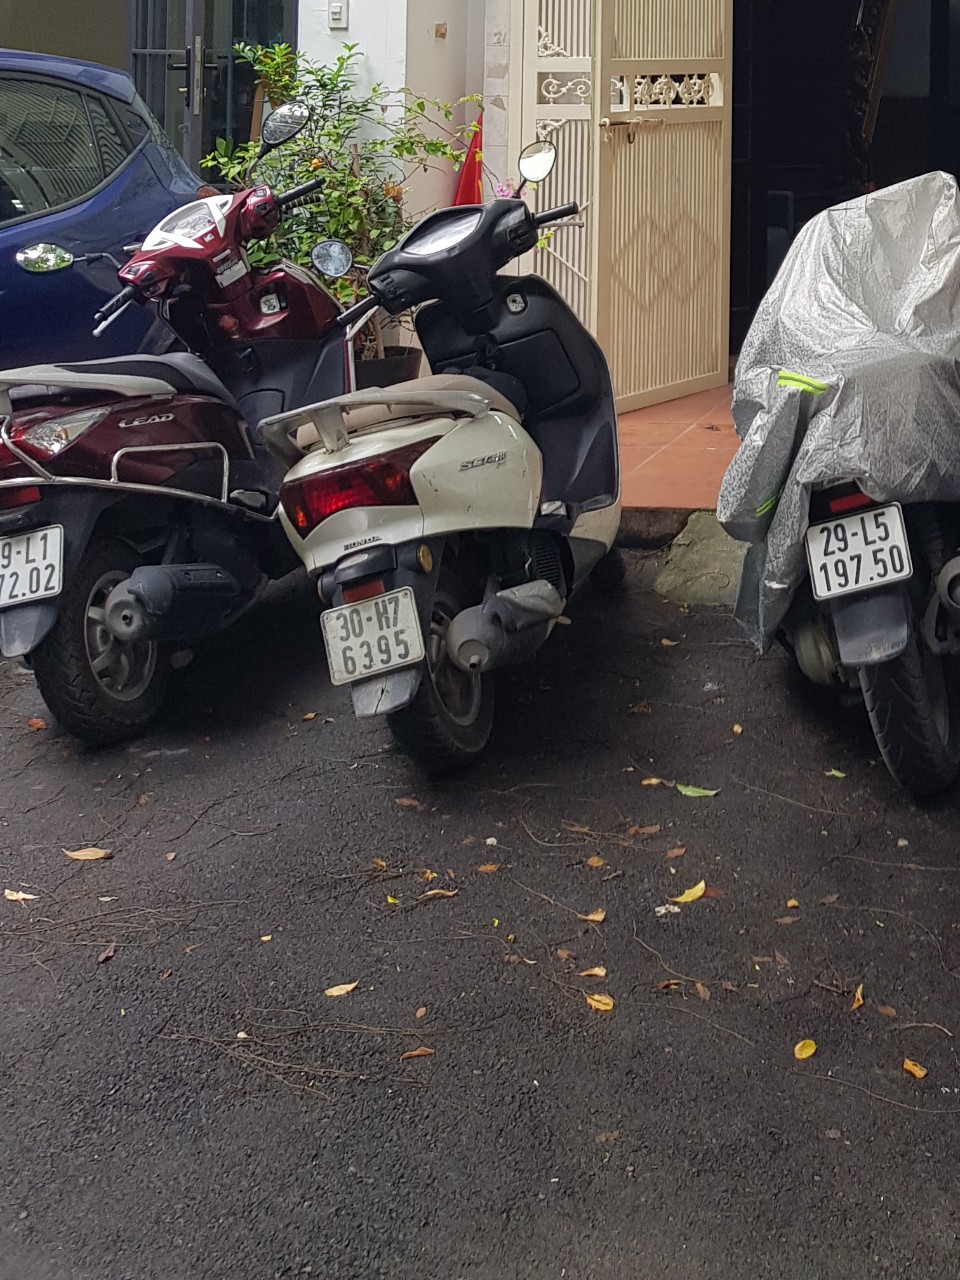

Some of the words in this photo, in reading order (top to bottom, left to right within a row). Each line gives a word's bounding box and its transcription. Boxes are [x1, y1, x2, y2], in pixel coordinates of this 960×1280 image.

[118, 413, 174, 428] LEAD
[0, 532, 49, 569] 9-L1
[819, 510, 890, 557] 29-L5
[819, 544, 905, 592] 197.50
[335, 595, 401, 642] 30-H7
[341, 628, 411, 676] 6395
